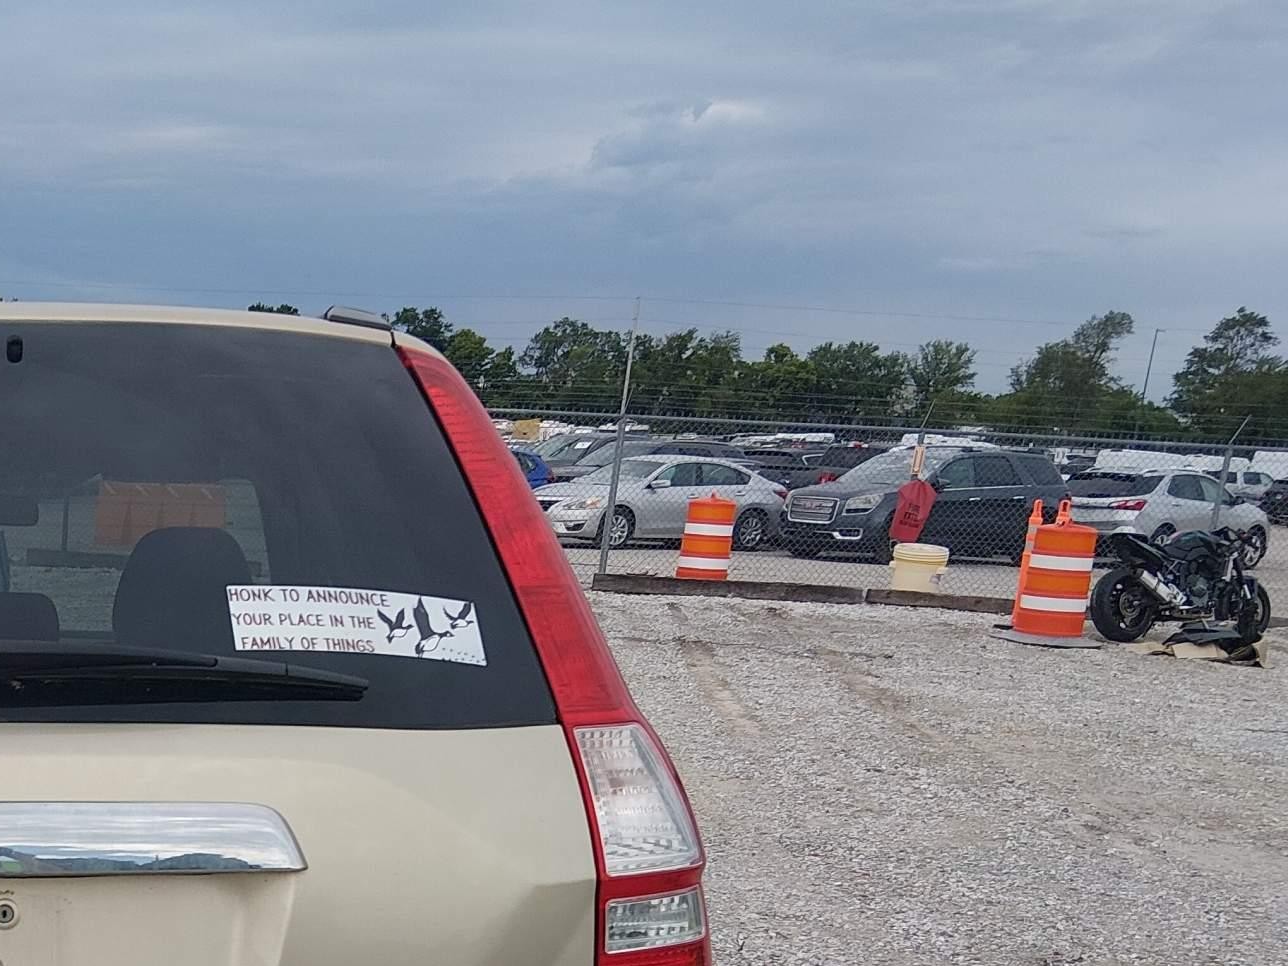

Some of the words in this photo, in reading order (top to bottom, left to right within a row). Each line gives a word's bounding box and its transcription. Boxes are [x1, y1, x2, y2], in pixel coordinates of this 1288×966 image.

[228, 588, 274, 602] HONK
[279, 588, 300, 602] TO
[306, 589, 391, 608] ANNOUNCE
[232, 613, 274, 626] YOUR
[279, 614, 325, 627] PLACE
[329, 615, 345, 628] IN
[350, 616, 376, 630] THE
[241, 636, 294, 650] FAMILY
[300, 637, 319, 650] OF
[324, 638, 375, 653] THINGS
